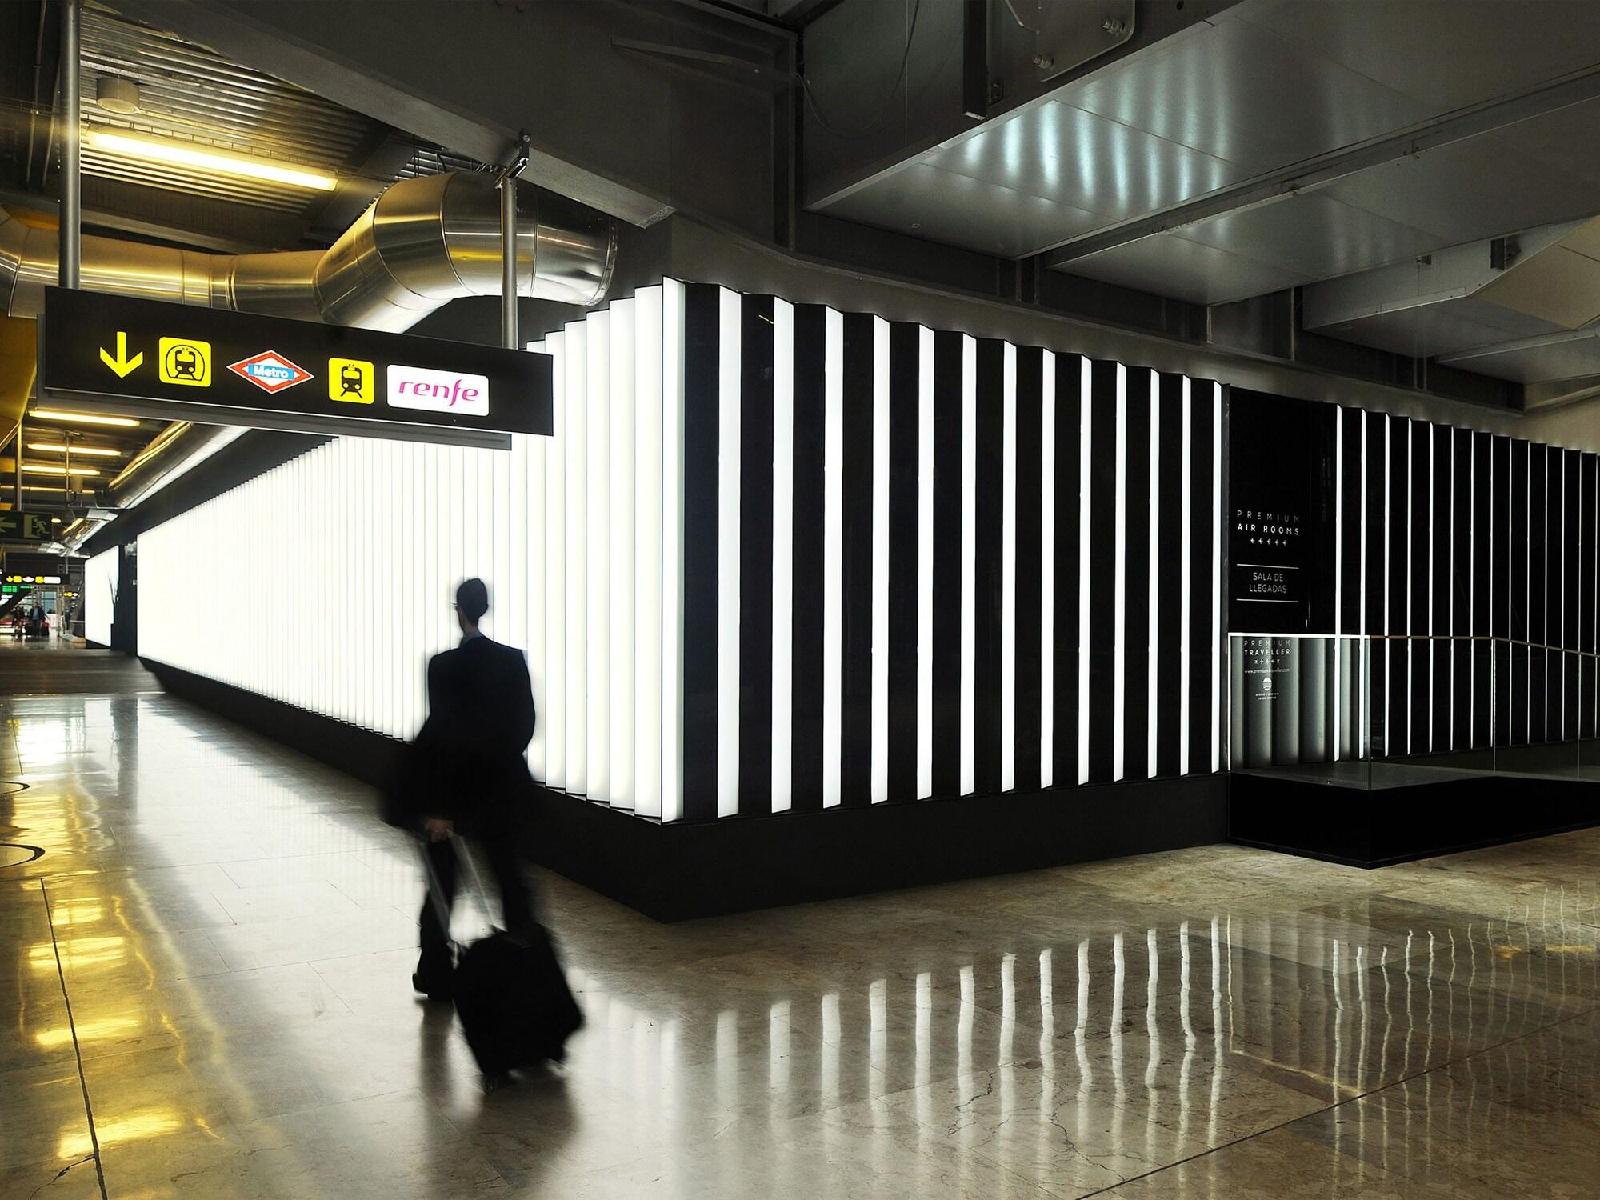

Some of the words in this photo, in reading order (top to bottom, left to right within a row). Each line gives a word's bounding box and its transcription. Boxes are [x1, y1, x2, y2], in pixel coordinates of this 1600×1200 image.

[253, 364, 289, 380] Metro
[398, 379, 479, 406] renfe
[1237, 509, 1299, 523] PREMIUM
[1237, 523, 1256, 532] AIR
[1263, 525, 1299, 536] ROOMS
[1252, 572, 1272, 582] SALA
[1273, 573, 1284, 582] DE
[1249, 583, 1287, 594] LLEGADAS
[1244, 639, 1291, 647] PREMIUM
[1244, 648, 1291, 656] TRAVELLER
